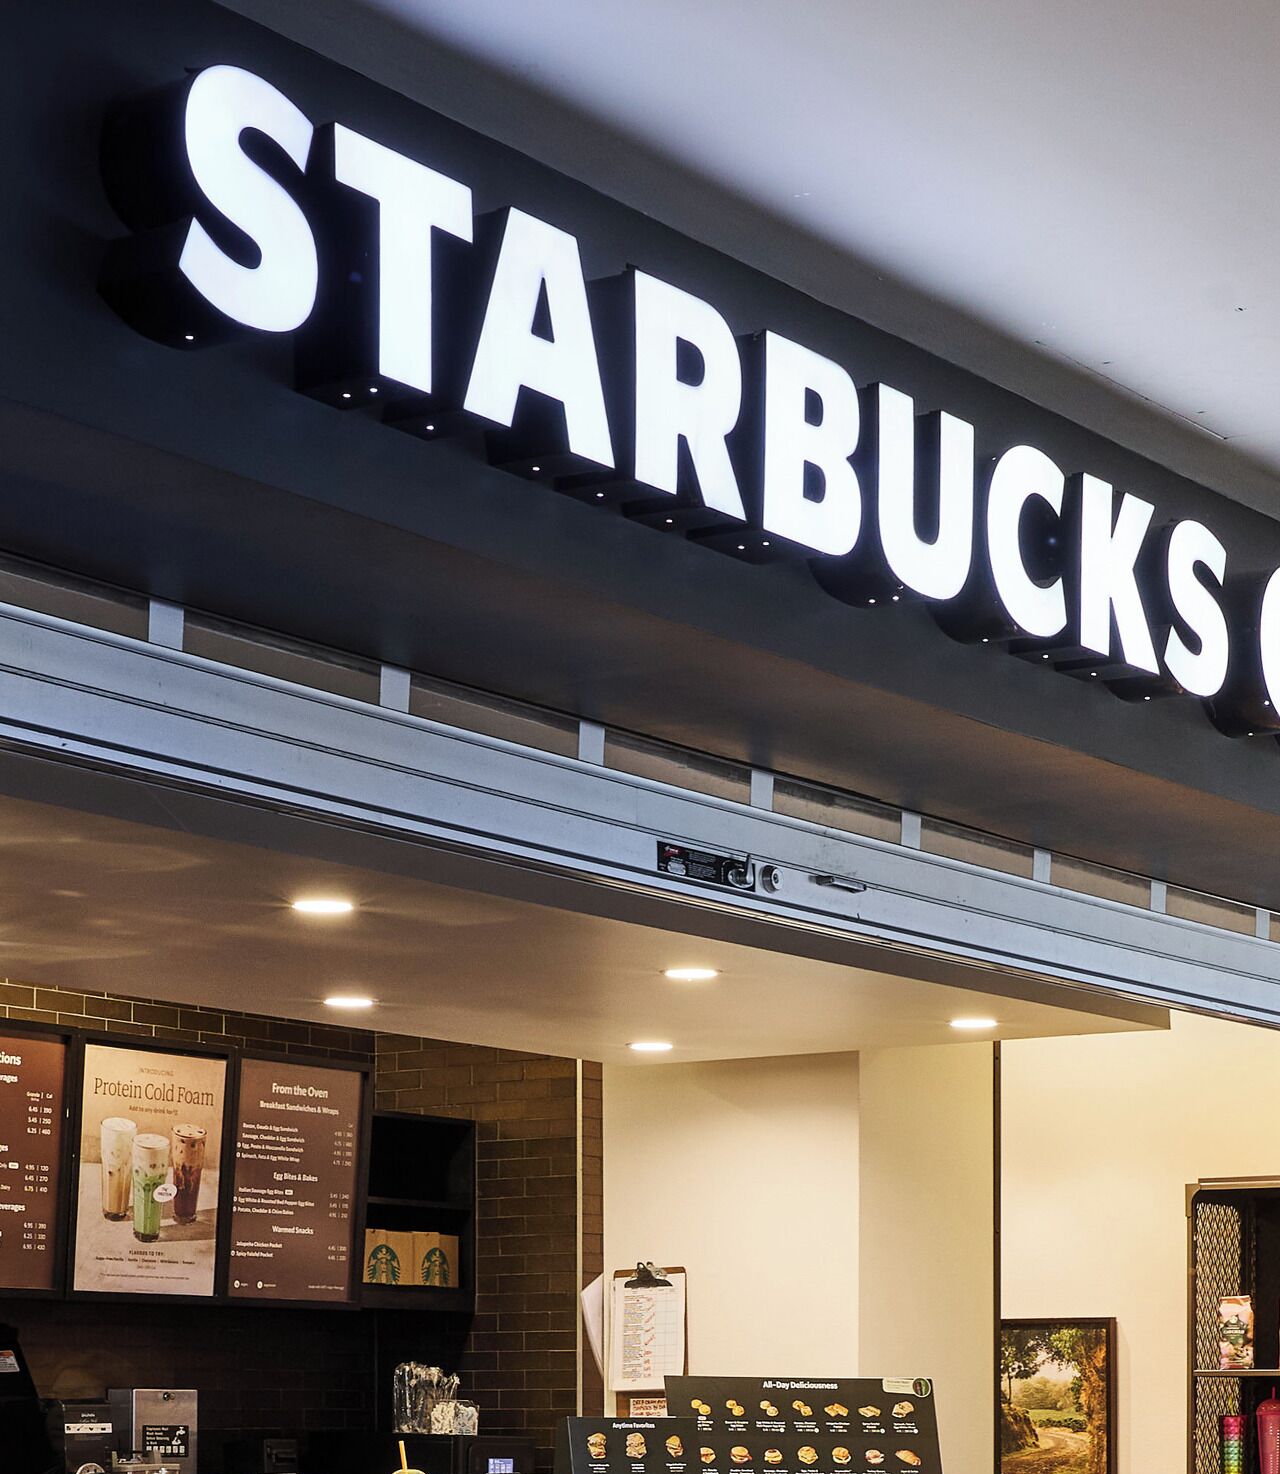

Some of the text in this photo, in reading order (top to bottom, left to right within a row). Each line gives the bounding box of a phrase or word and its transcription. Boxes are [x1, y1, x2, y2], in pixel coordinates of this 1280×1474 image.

[178, 64, 1230, 698] STARBUCKS
[94, 1077, 214, 1106] Protein Cold Foam
[272, 1083, 328, 1098] From the Oven
[260, 1101, 286, 1110] Breakfast
[790, 1381, 838, 1390] Deliciousness
